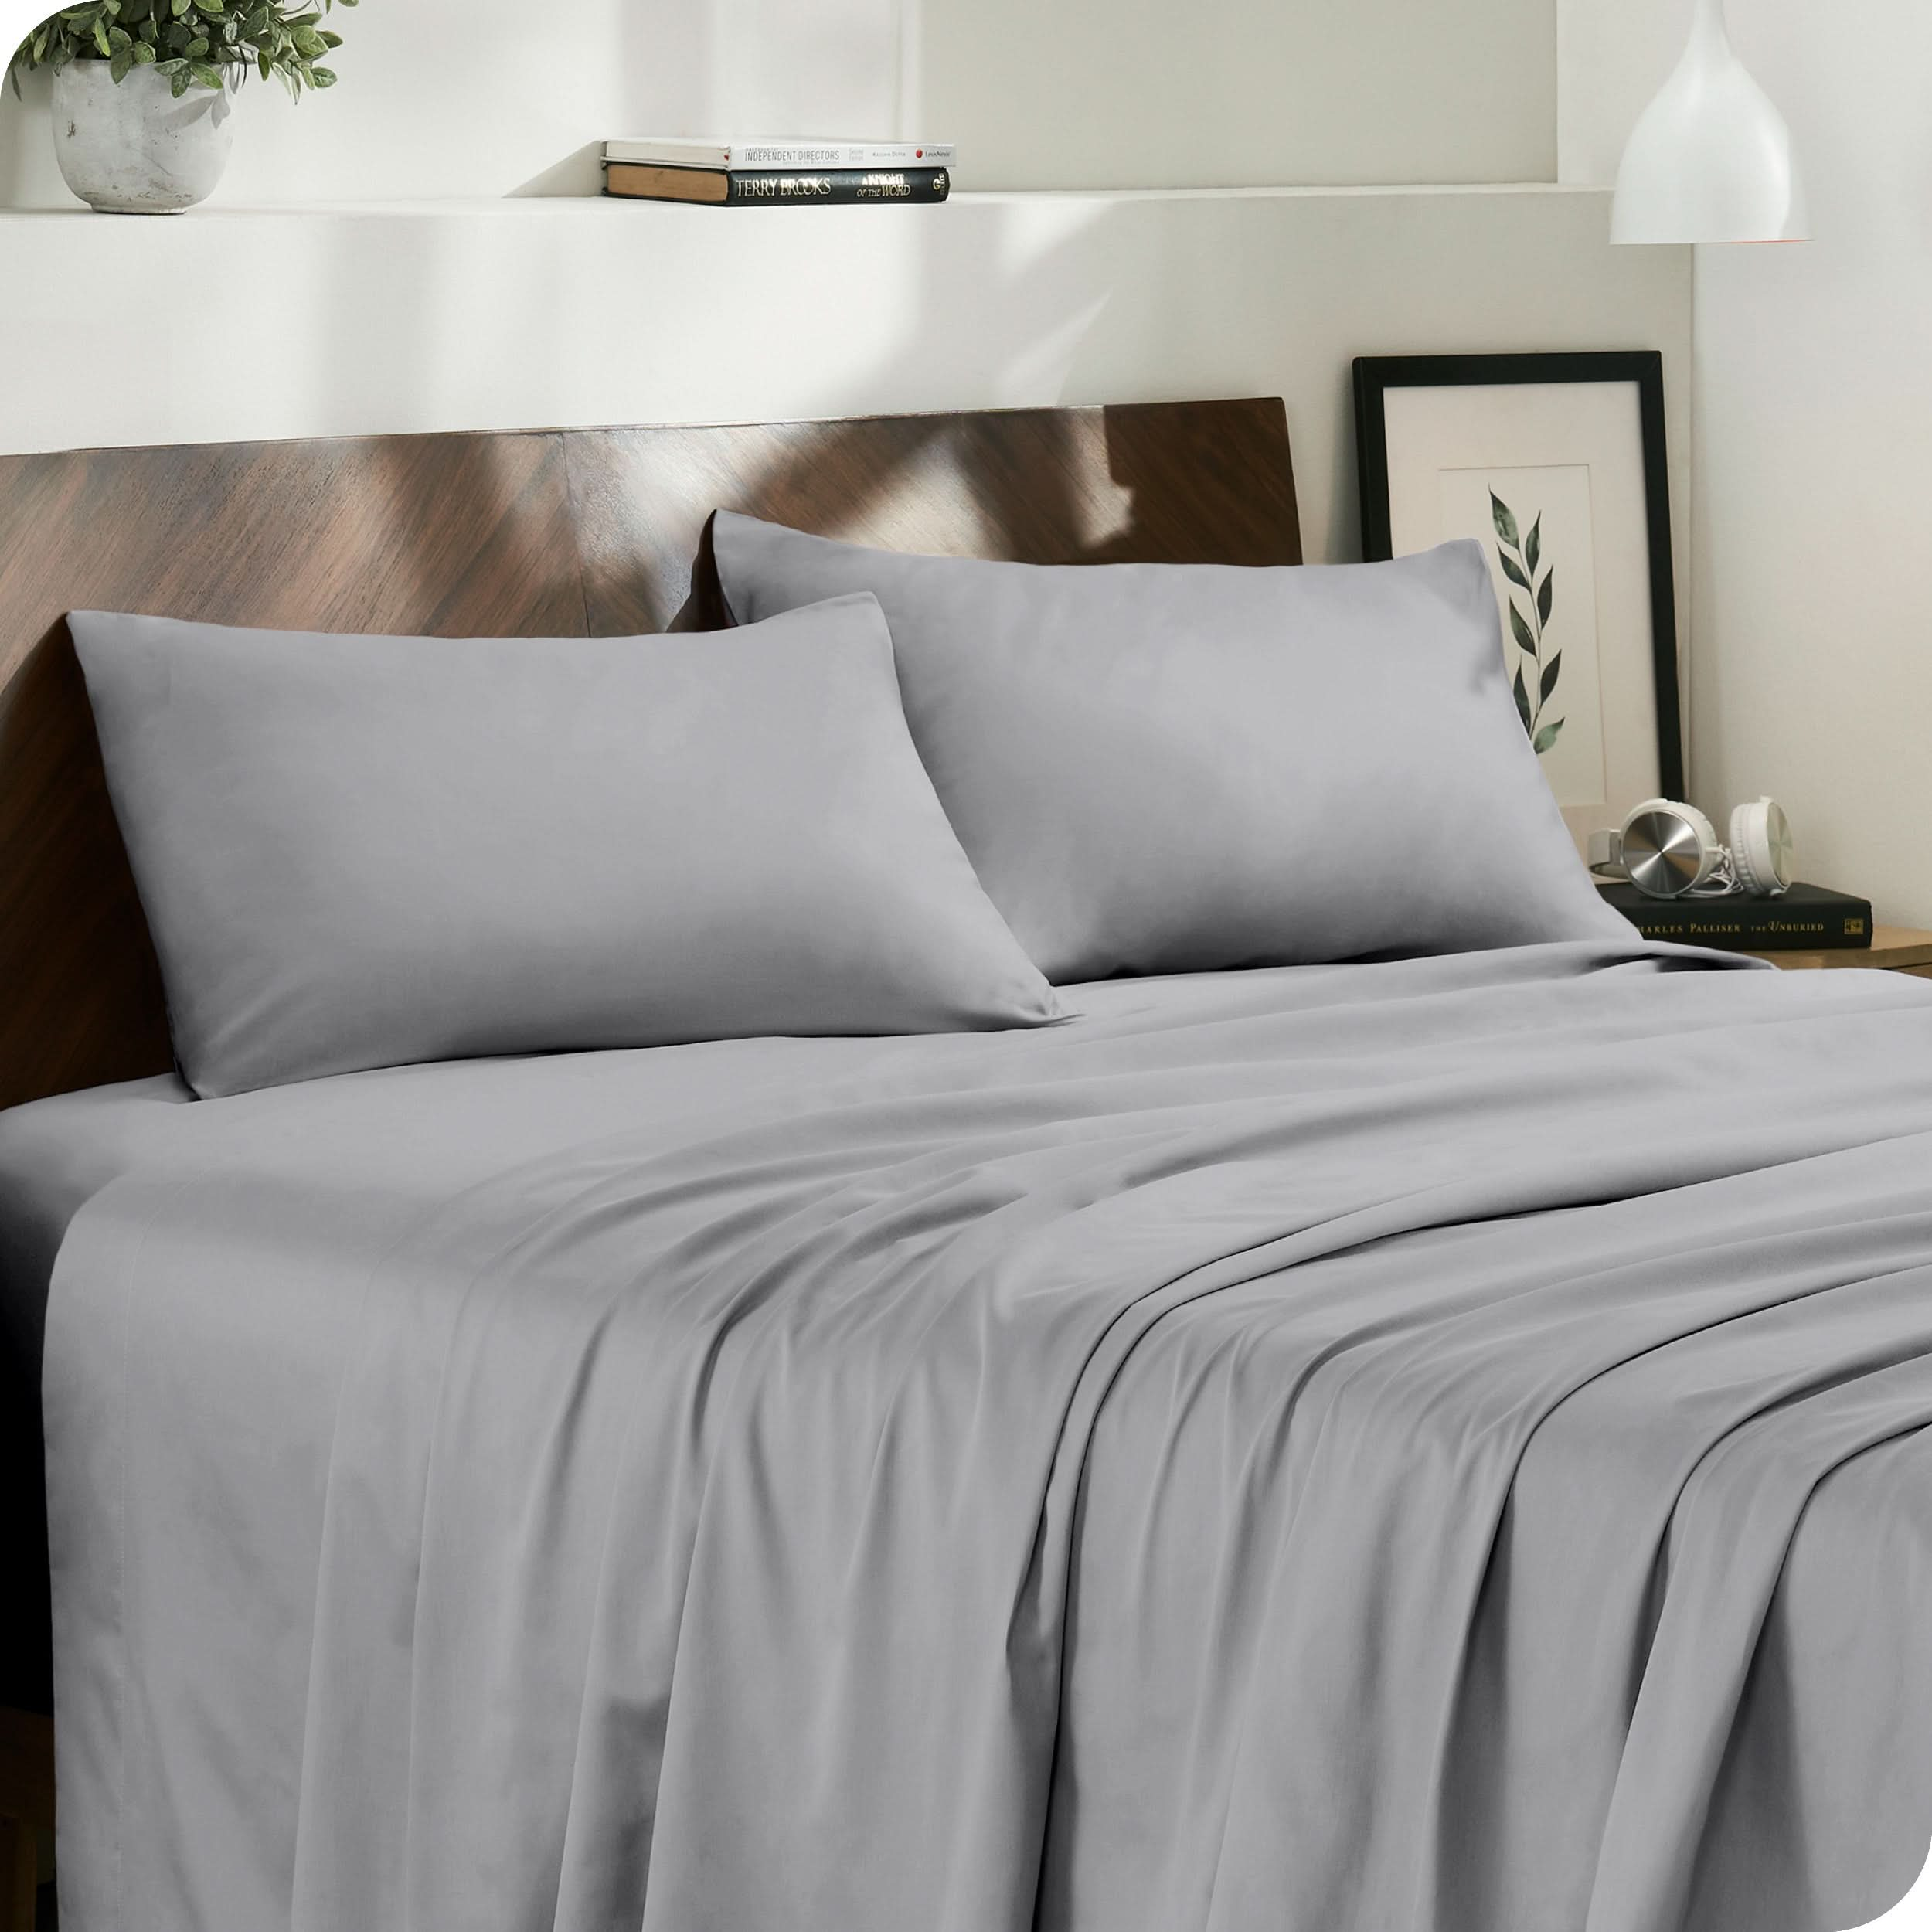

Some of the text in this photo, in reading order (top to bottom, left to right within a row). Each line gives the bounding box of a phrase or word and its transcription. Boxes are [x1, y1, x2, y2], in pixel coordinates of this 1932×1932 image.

[745, 151, 795, 161] INDEPENDENT
[798, 149, 840, 161] DIRECTORS
[867, 174, 904, 186] KNIGHT
[736, 177, 831, 196] TERRY BROOKS
[856, 184, 910, 198] OF THE WORD
[1690, 923, 1740, 933] PALLISER
